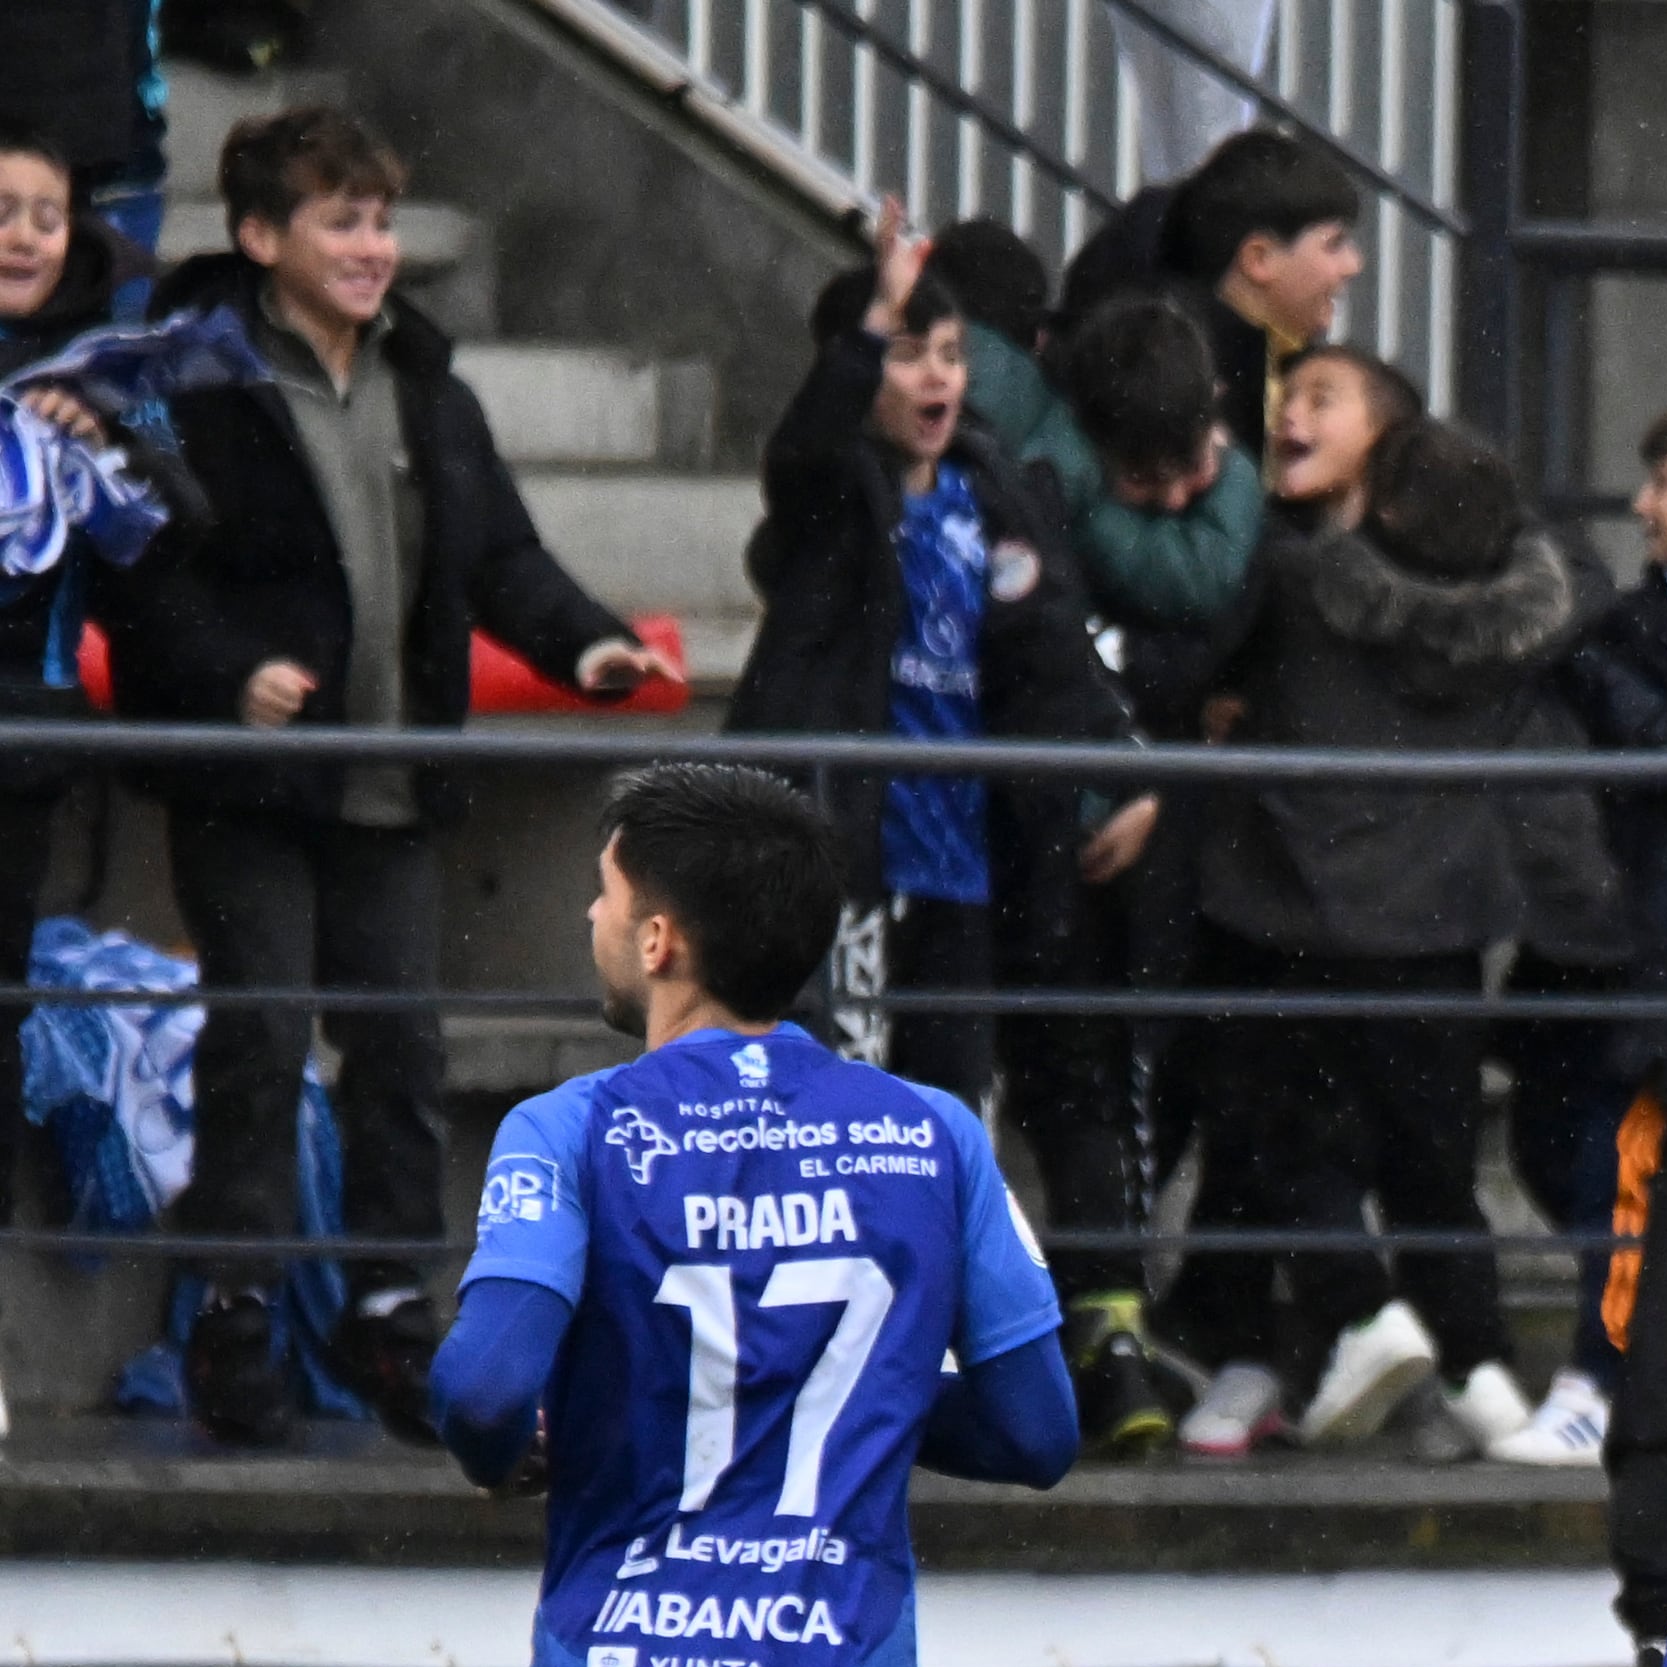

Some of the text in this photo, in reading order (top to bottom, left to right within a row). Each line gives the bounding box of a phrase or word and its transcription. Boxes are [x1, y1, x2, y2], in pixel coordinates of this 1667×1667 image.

[679, 1099, 786, 1119] HOSPITAL
[683, 1115, 936, 1153] recoletas salud
[799, 1155, 936, 1177] EL CARMEN
[683, 1189, 857, 1250] PRADA
[654, 1256, 894, 1518] 17
[665, 1523, 846, 1573] Levagalia
[594, 1589, 843, 1645] ABANCA
